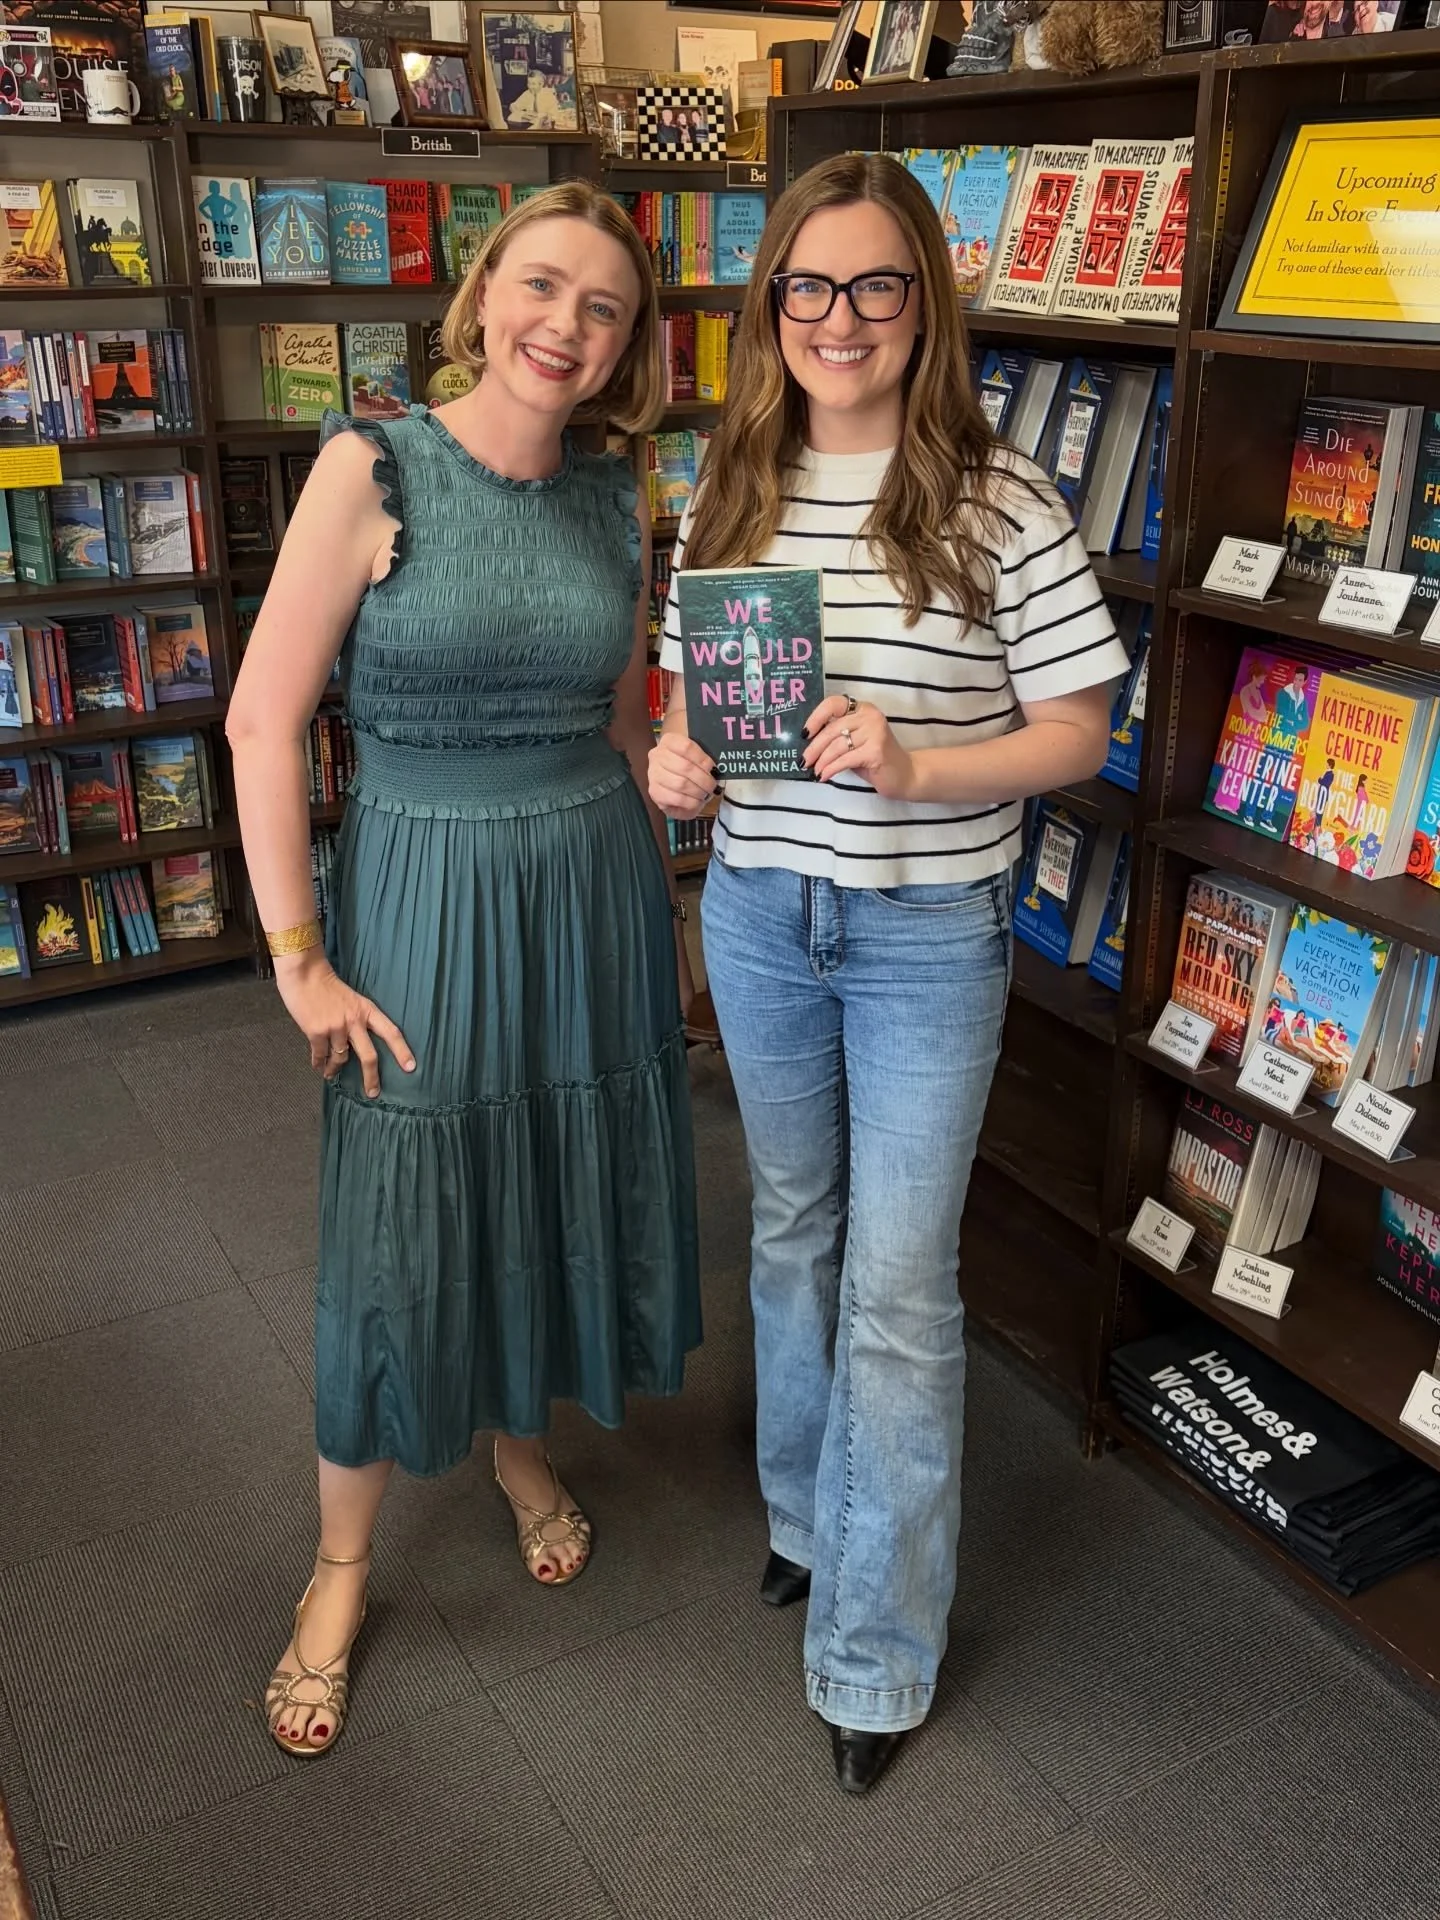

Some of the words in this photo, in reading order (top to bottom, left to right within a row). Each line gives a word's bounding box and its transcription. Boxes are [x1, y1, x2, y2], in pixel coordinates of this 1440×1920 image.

[164, 27, 181, 35] SECRET
[167, 44, 183, 52] CLOCK
[227, 59, 261, 71] POISON
[411, 136, 452, 151] British
[1033, 150, 1044, 167] 10
[1094, 145, 1105, 164] 10
[1104, 146, 1166, 165] MARCHFIELD
[964, 176, 984, 187] EVERY
[987, 178, 1001, 188] TIME
[1336, 167, 1438, 194] Upcoming
[347, 192, 364, 200] THE
[454, 195, 496, 208] STRANGER
[959, 194, 998, 208] VACATION
[1131, 171, 1159, 230] SQUARE
[290, 205, 294, 218] I
[329, 202, 386, 221] FELLOWSHIP
[455, 211, 489, 223] DIARIES
[963, 208, 989, 216] Someone
[1305, 200, 1323, 221] In
[1328, 200, 1377, 222] Store
[213, 221, 239, 235] the
[272, 222, 316, 240] SEE
[965, 218, 981, 229] DIES
[336, 236, 381, 251] PUZZLE
[999, 226, 1021, 278] SQUARE
[1282, 238, 1304, 253] Not
[1306, 240, 1352, 254] familiar
[1354, 241, 1379, 255] with
[1382, 245, 1397, 255] an
[268, 245, 324, 264] YOU
[335, 248, 382, 262] MAKERS
[391, 250, 424, 272] URDER
[1064, 227, 1087, 283] SQUARE
[1129, 228, 1158, 286] SQUARE
[220, 262, 256, 280] Lovesey
[338, 265, 363, 273] SAMUEL
[365, 265, 381, 273] BURR
[1277, 257, 1295, 275] Try
[1296, 263, 1317, 273] one
[1318, 259, 1332, 274] of
[1332, 259, 1363, 274] these
[1364, 261, 1404, 277] earlier
[993, 284, 1039, 305] MARCHFIELD
[1060, 289, 1113, 312] MARCHFIELD
[1122, 292, 1179, 312] MARCHFIELD
[353, 326, 404, 339] AGATHA
[283, 333, 332, 354] Agatha
[353, 341, 406, 353] CHRISTIE
[284, 351, 333, 367] Christie
[356, 356, 374, 365] FIVE
[376, 356, 404, 365] LITTLE
[371, 367, 391, 376] PIGS
[292, 376, 331, 389] TOWARDS
[442, 378, 468, 388] CLOCKS
[288, 386, 333, 403] ZERO
[656, 434, 692, 446] GATHA
[655, 447, 694, 458] HRISTIE
[1238, 547, 1260, 560] Mark
[1232, 559, 1255, 574] Pryor
[724, 597, 772, 625] WE
[1335, 607, 1350, 616] April
[690, 637, 813, 667] WOULD
[700, 679, 806, 706] NEVER
[775, 699, 799, 710] NOVEL
[722, 715, 790, 741] TELL
[1266, 710, 1283, 728] THE
[1321, 696, 1404, 744] KATHERINE
[1229, 715, 1309, 755] ROM-COMMERS
[719, 749, 798, 760] ANNE-SOPHIE
[1325, 730, 1383, 772] CENTER
[719, 761, 807, 774] OUHANNEA
[1219, 739, 1302, 791] KATHERINE
[1335, 770, 1354, 789] THE
[1221, 770, 1278, 812] CENTER
[1299, 779, 1388, 836] BODYGUARD
[1044, 837, 1072, 859] EVERYONE
[1052, 856, 1070, 874] BANK
[1047, 868, 1067, 891] THIEF
[1040, 920, 1067, 948] STEVENSON
[1187, 910, 1204, 922] JOE
[1206, 917, 1263, 946] PAPPALARDO
[1184, 926, 1218, 968] RED
[1222, 943, 1258, 985] SKY
[1303, 941, 1337, 963] EVERY
[1339, 956, 1364, 977] TIME
[1180, 959, 1249, 1009] MORNING
[1301, 975, 1346, 1002] Someone
[1177, 986, 1205, 1005] TEXAS
[1207, 1001, 1246, 1026] RANGER
[1306, 989, 1333, 1011] DIES
[1181, 1016, 1193, 1028] Joe
[1165, 1020, 1199, 1046] Pappalardo
[1263, 1051, 1299, 1076] Catherine
[1264, 1066, 1285, 1084] Mack
[1366, 1092, 1393, 1115] Nicolas
[1211, 1103, 1254, 1140] ROSS
[1355, 1102, 1390, 1130] Didomizio
[1169, 1127, 1242, 1209] IMPOSTOR
[1153, 1225, 1168, 1240] Ross
[1415, 1223, 1439, 1251] HE
[1385, 1233, 1437, 1279] KEPT
[1241, 1259, 1270, 1277] Joshua
[1232, 1268, 1272, 1293] Moehling
[1377, 1275, 1403, 1299] JOSHUA
[1399, 1264, 1440, 1305] HER
[1189, 1350, 1318, 1460] Holmes&
[1150, 1365, 1272, 1474] Watson&
